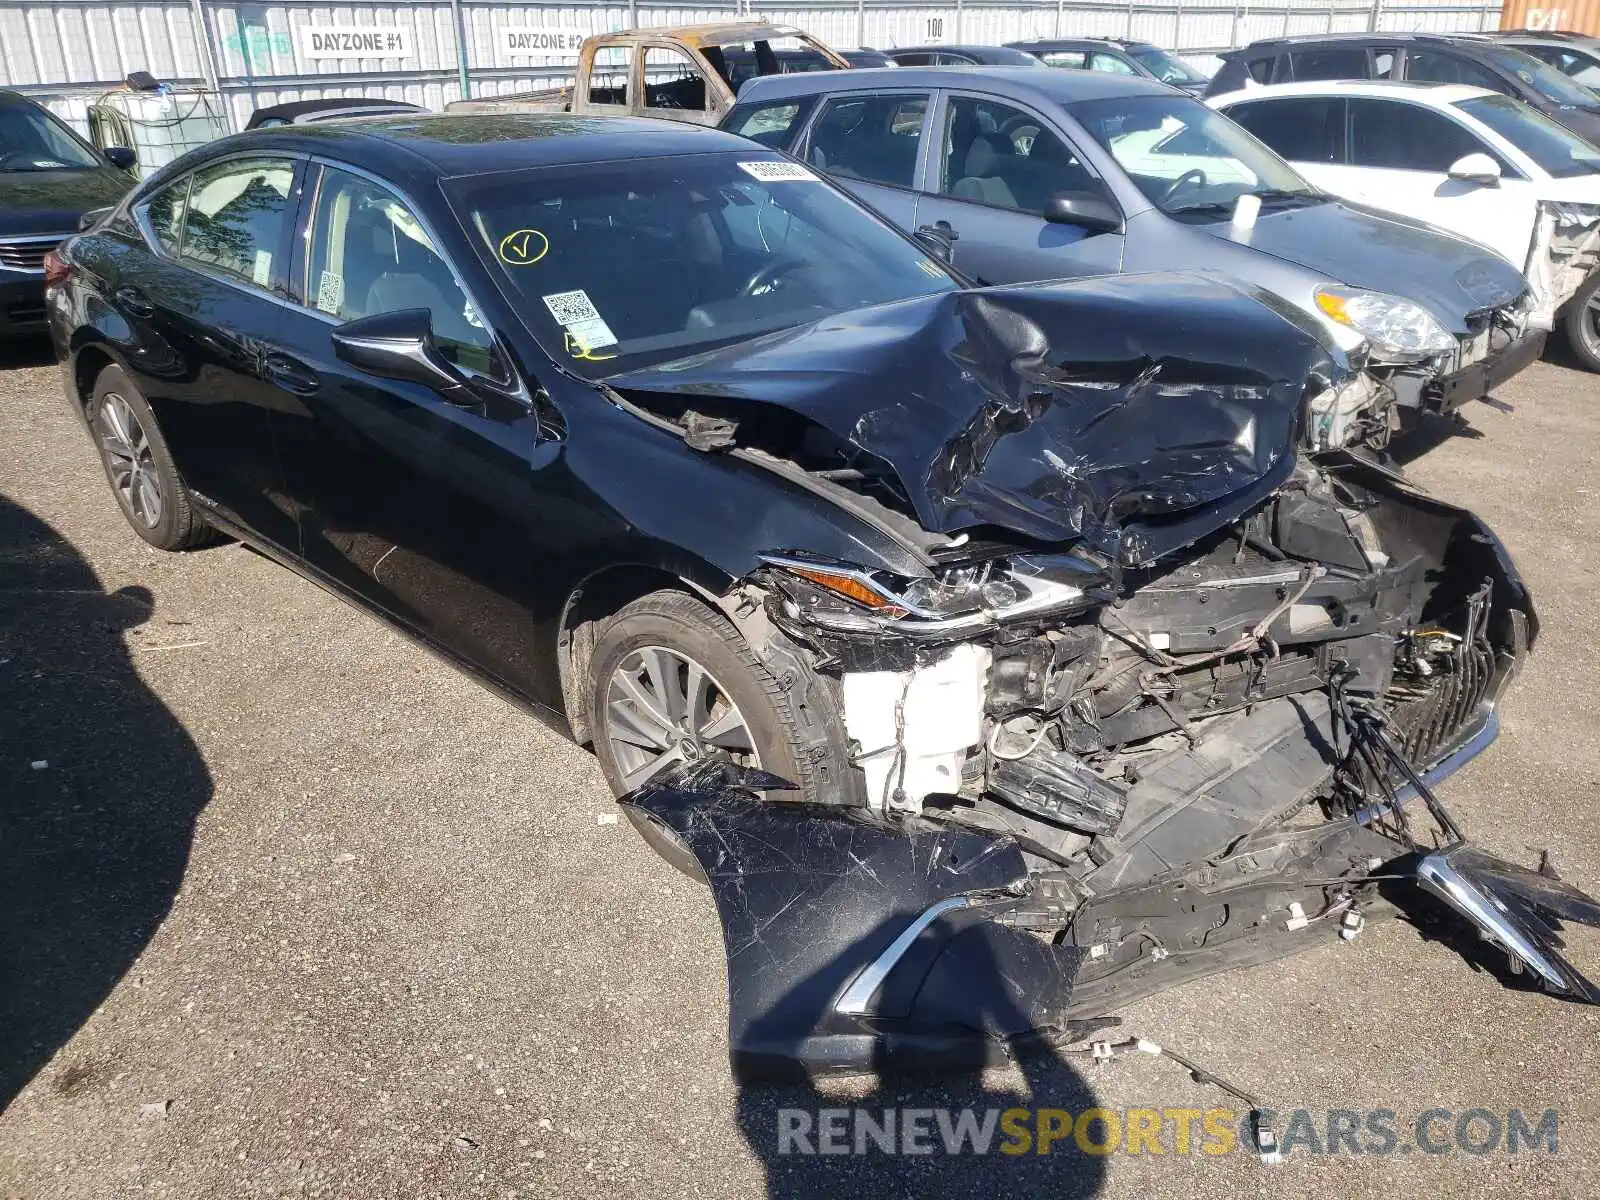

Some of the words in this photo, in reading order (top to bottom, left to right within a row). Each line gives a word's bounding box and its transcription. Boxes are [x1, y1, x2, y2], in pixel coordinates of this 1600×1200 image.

[927, 17, 943, 38] 100
[311, 32, 384, 51] DAYZONE
[386, 32, 403, 51] #1
[508, 33, 566, 50] DAYZONE
[568, 34, 584, 51] #2
